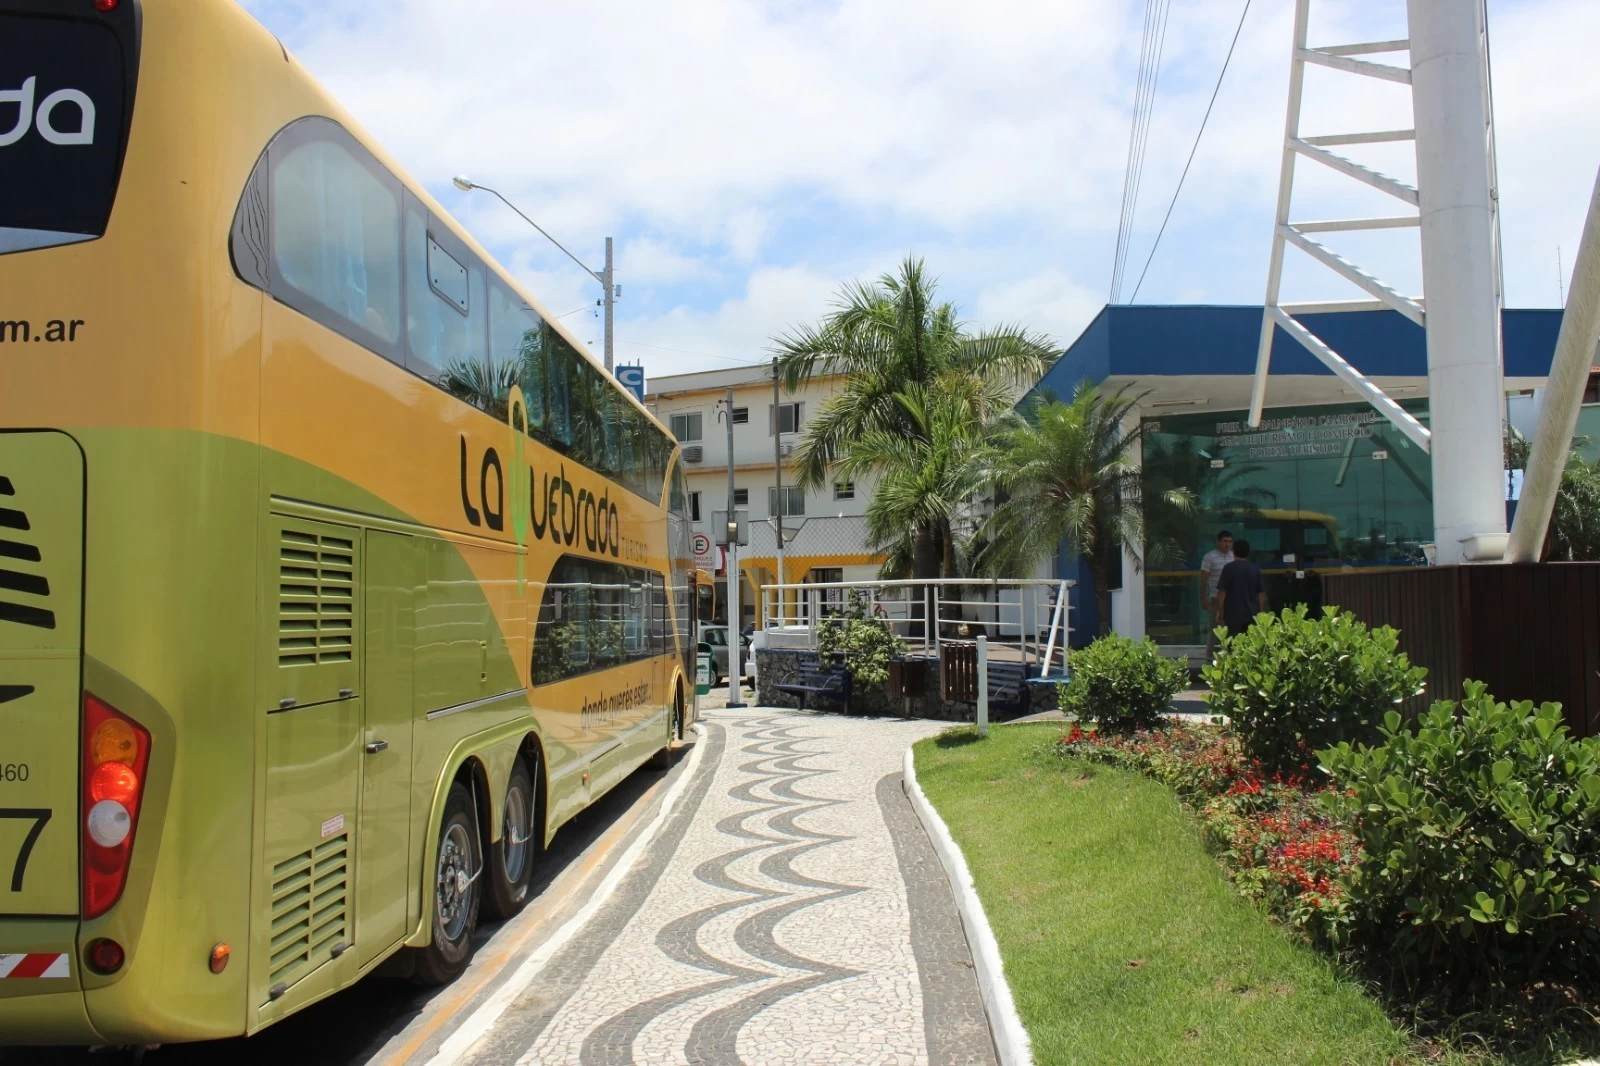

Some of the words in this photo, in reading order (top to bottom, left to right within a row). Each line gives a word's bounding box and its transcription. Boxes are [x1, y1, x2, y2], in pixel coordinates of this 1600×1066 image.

[0, 320, 85, 343] m.ar
[1319, 410, 1376, 425] CAMBORIÚ
[1259, 430, 1304, 444] TURISMO
[1250, 446, 1288, 459] PORTAL
[696, 540, 704, 551] E
